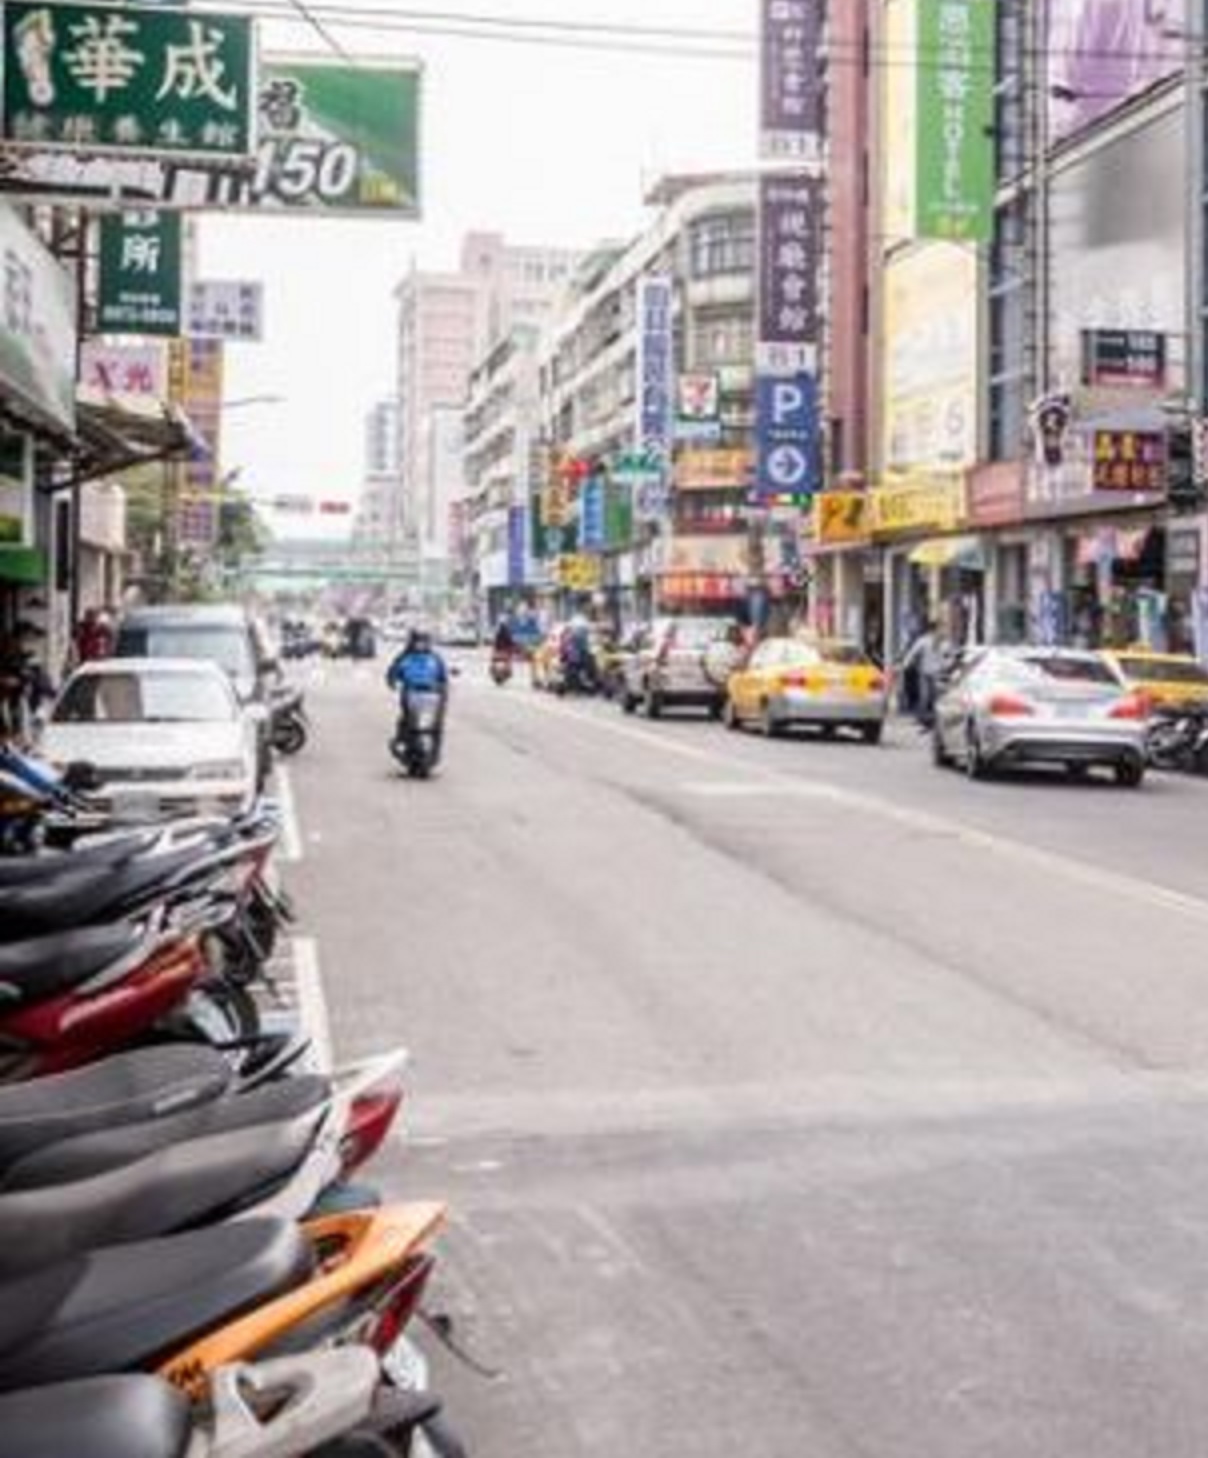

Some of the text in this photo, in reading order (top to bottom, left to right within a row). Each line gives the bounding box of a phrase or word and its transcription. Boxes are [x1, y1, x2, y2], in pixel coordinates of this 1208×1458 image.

[61, 14, 238, 111] 華成
[252, 142, 357, 198] 150
[773, 384, 802, 423] P
